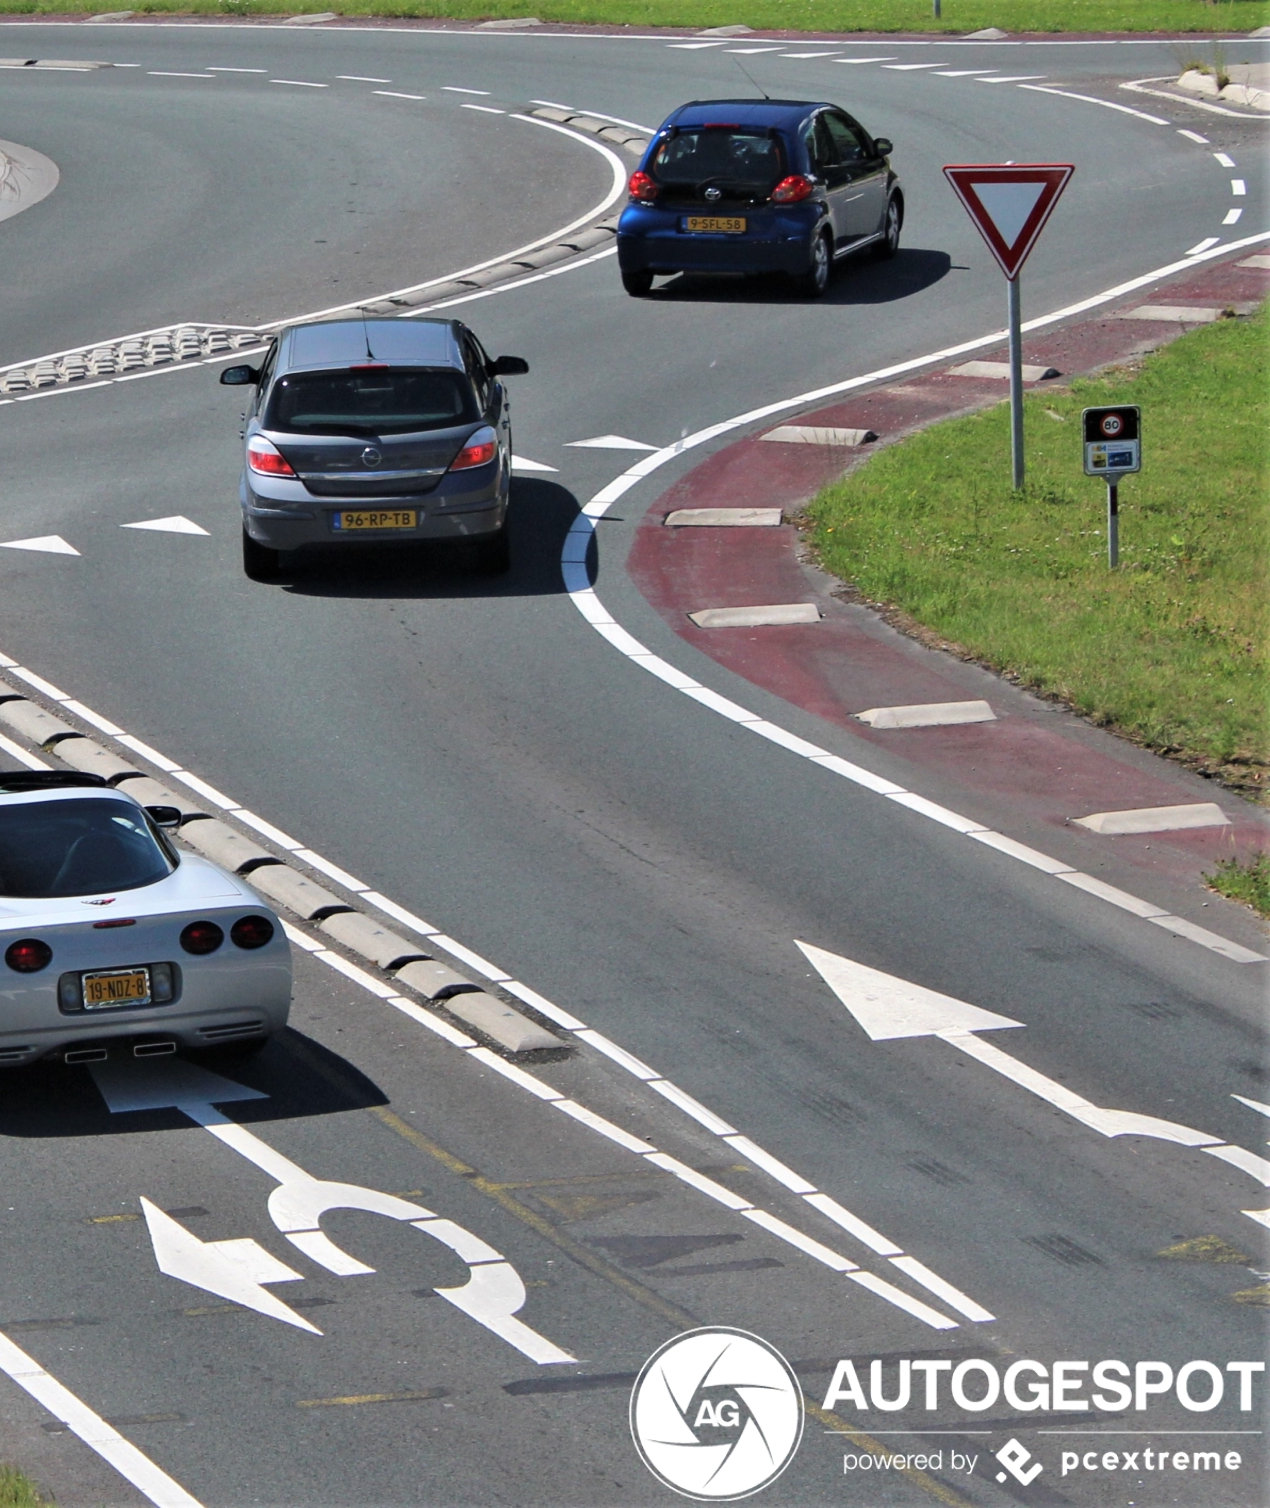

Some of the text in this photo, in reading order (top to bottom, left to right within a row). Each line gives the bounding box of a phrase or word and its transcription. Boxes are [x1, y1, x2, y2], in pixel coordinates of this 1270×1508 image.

[690, 218, 741, 230] 9-SFL-58
[1104, 420, 1119, 430] 80
[345, 512, 411, 527] 96-RP-TB
[89, 978, 145, 1000] 19-NDZ-8
